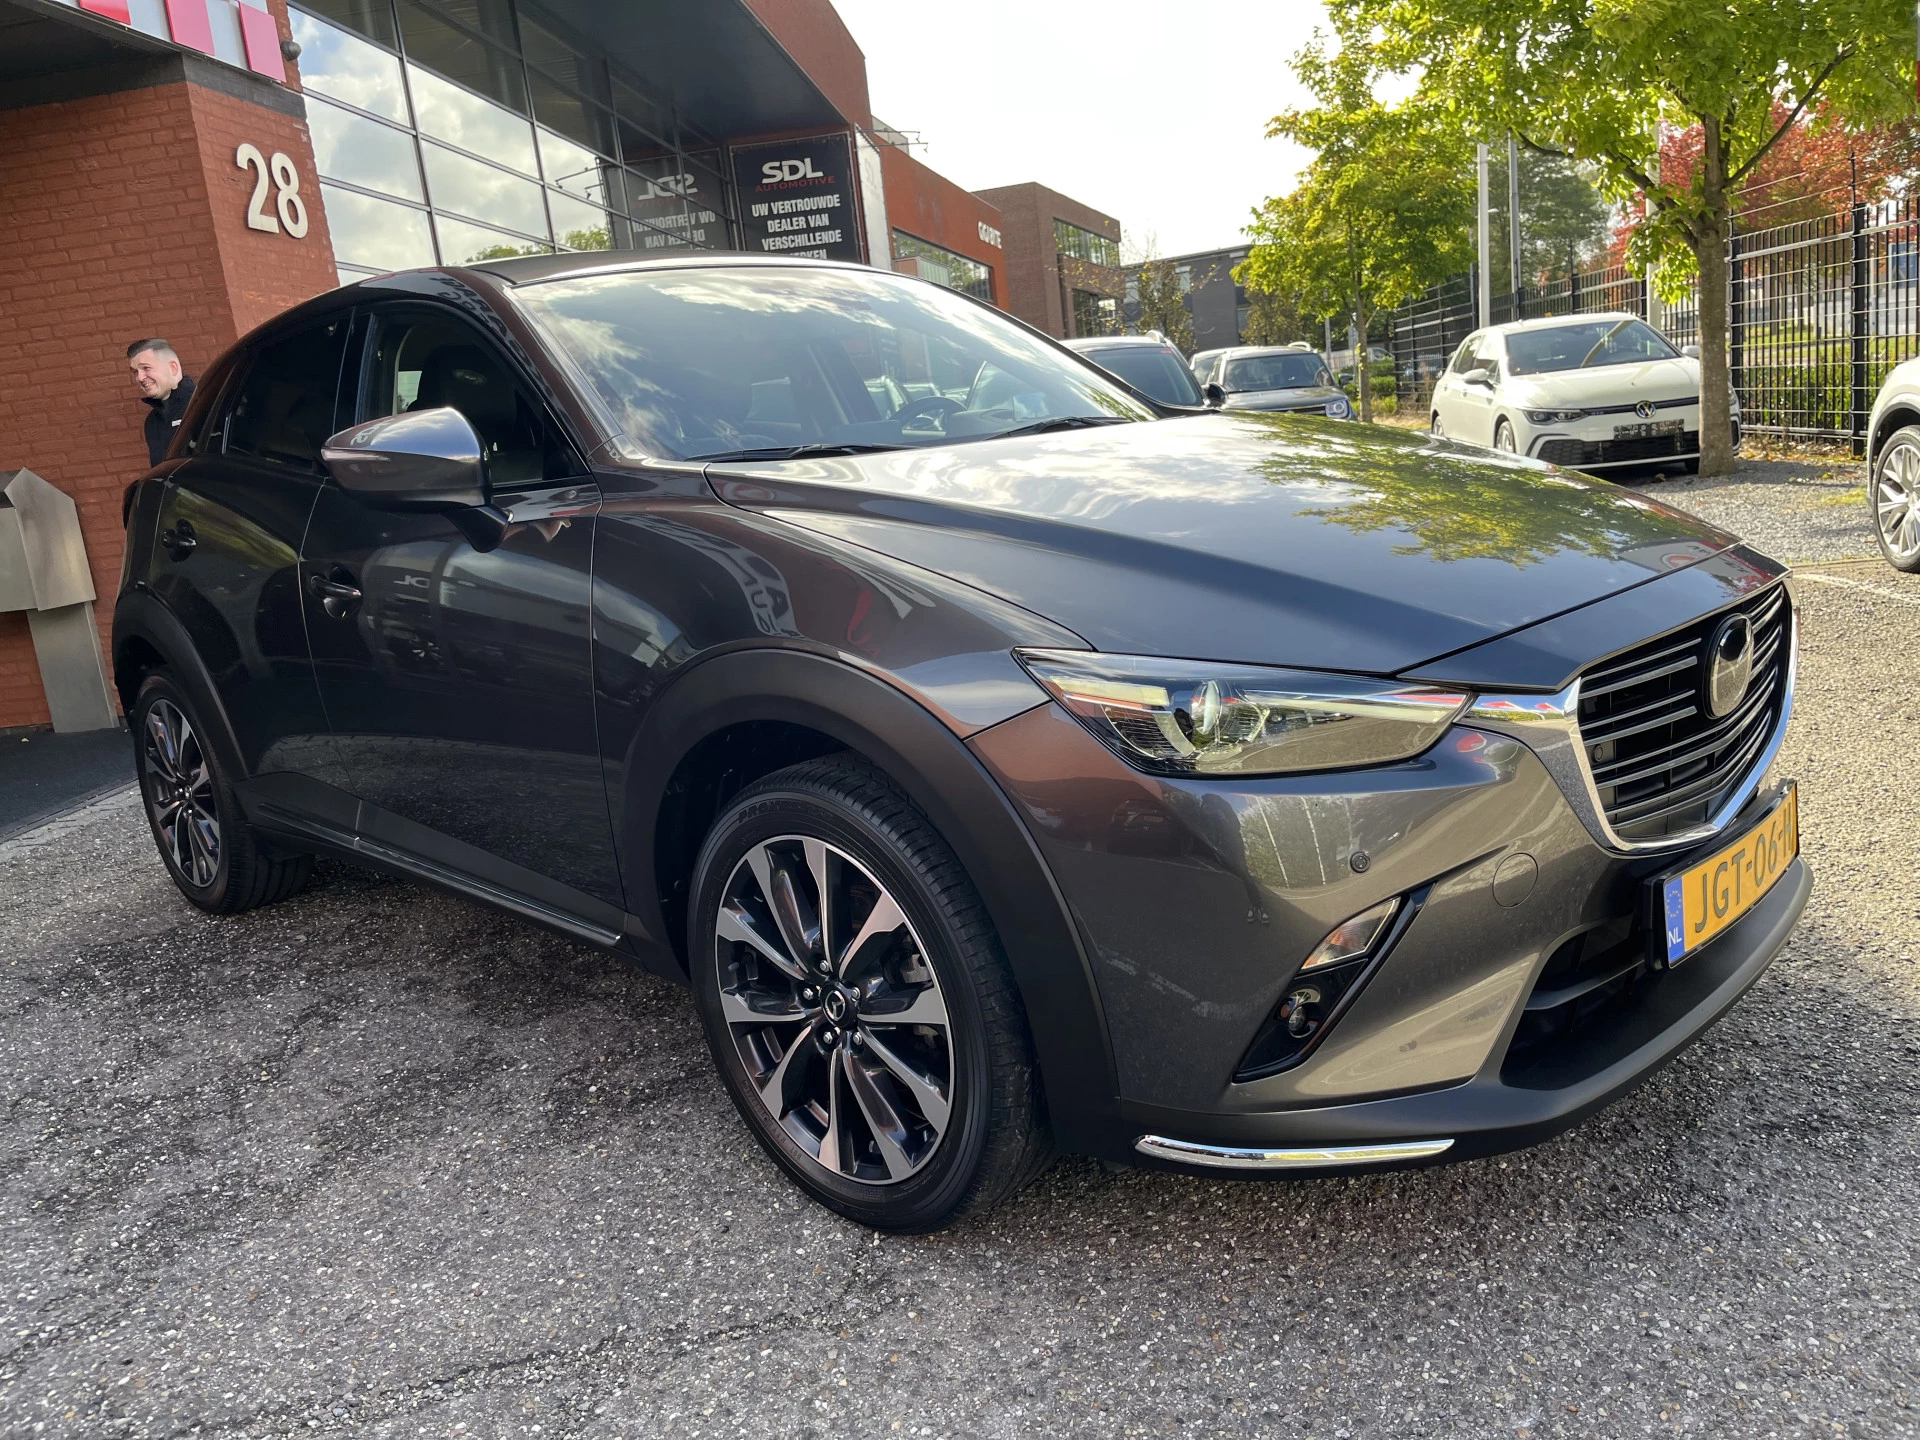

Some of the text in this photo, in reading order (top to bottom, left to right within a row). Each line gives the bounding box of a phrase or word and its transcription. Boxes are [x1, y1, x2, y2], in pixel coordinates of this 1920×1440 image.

[761, 157, 824, 184] SDL
[236, 143, 308, 239] 28
[755, 175, 836, 192] AUTOMOTIVE
[752, 194, 841, 217] UW VERTROUWDE
[767, 213, 830, 233] DEALER VAN
[761, 229, 842, 251] VERSCHILLENDE
[1695, 802, 1792, 933] JGT-06-H
[1668, 926, 1682, 948] NL
